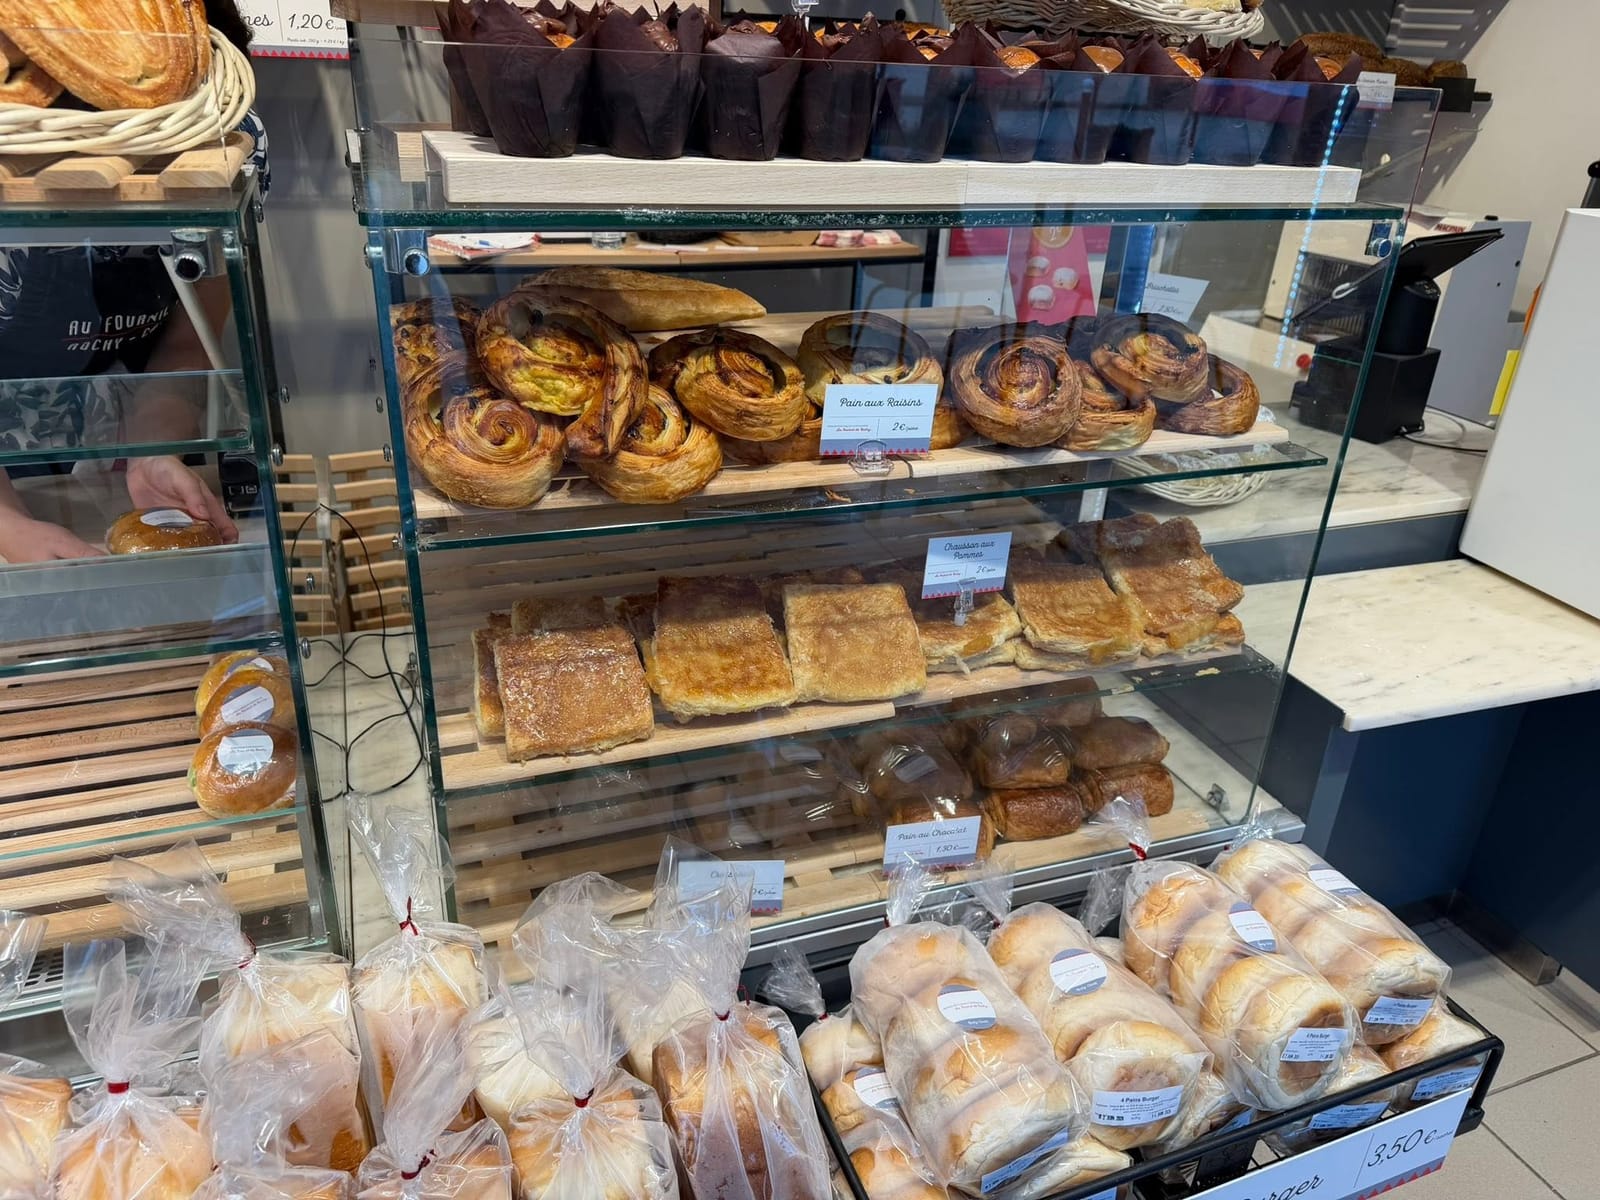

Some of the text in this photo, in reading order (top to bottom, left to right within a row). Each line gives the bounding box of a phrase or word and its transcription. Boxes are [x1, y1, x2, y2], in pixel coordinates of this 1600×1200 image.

[69, 320, 92, 336] AU
[840, 397, 923, 408] Pain aux Raisins
[944, 541, 996, 552] Chausson aux
[953, 551, 985, 560] Pommes
[898, 832, 916, 841] Pain
[1142, 1095, 1161, 1103] Burger
